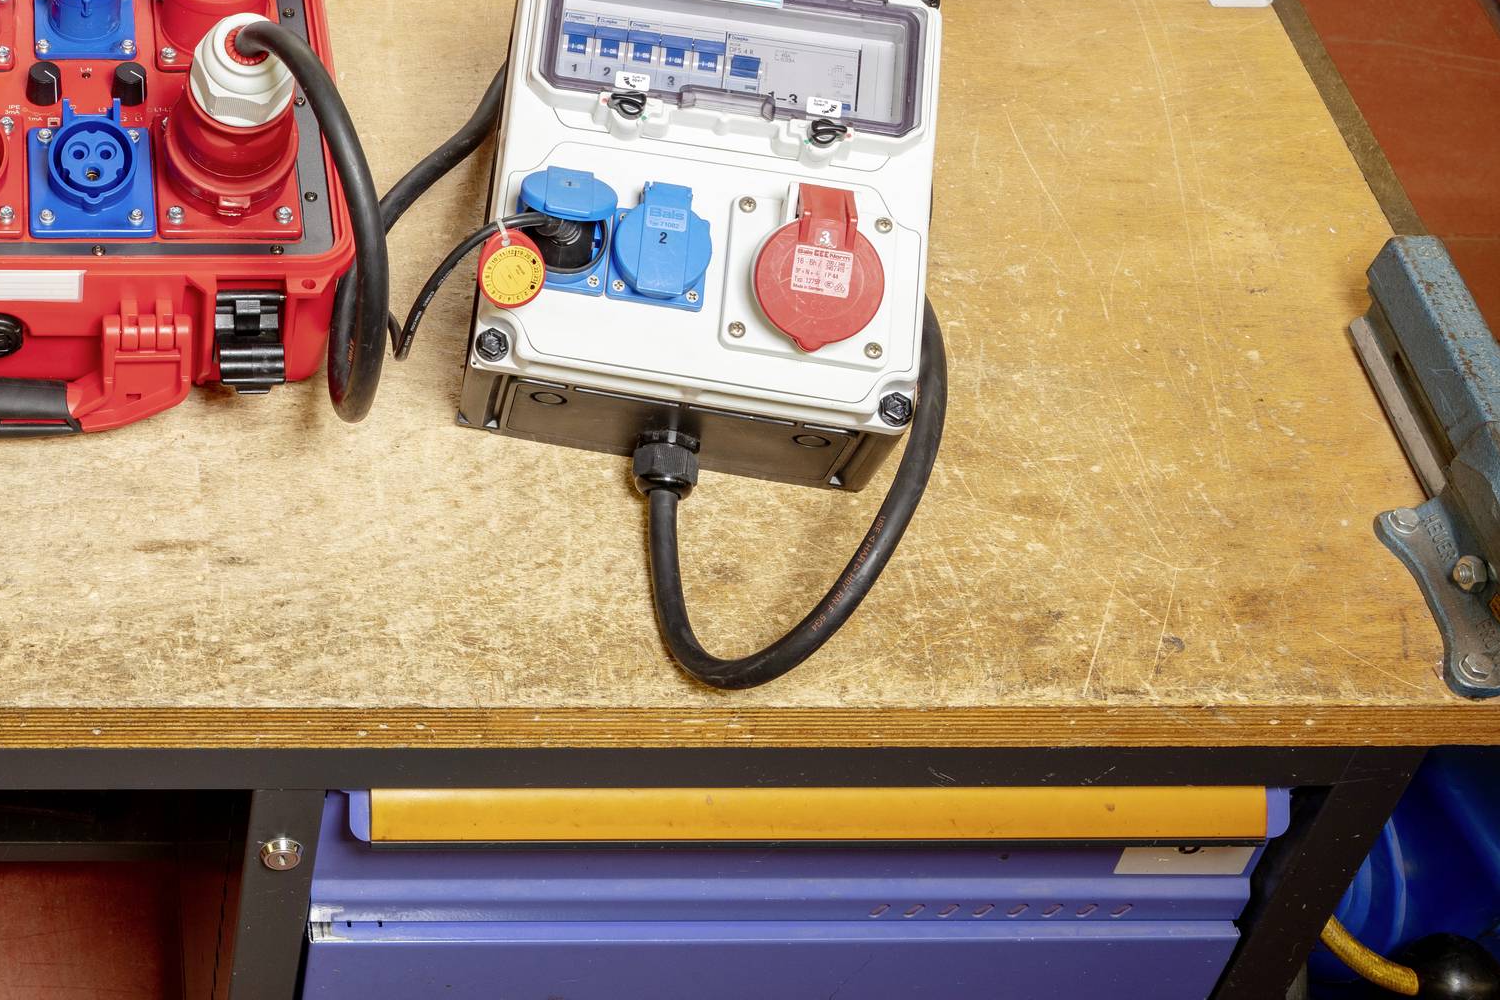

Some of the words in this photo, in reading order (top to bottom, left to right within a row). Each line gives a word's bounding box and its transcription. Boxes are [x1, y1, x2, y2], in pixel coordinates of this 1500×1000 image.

[572, 64, 577, 72] 1
[668, 76, 675, 86] 3
[649, 207, 684, 220] Bals
[658, 232, 667, 244] 2
[820, 230, 831, 244] 3
